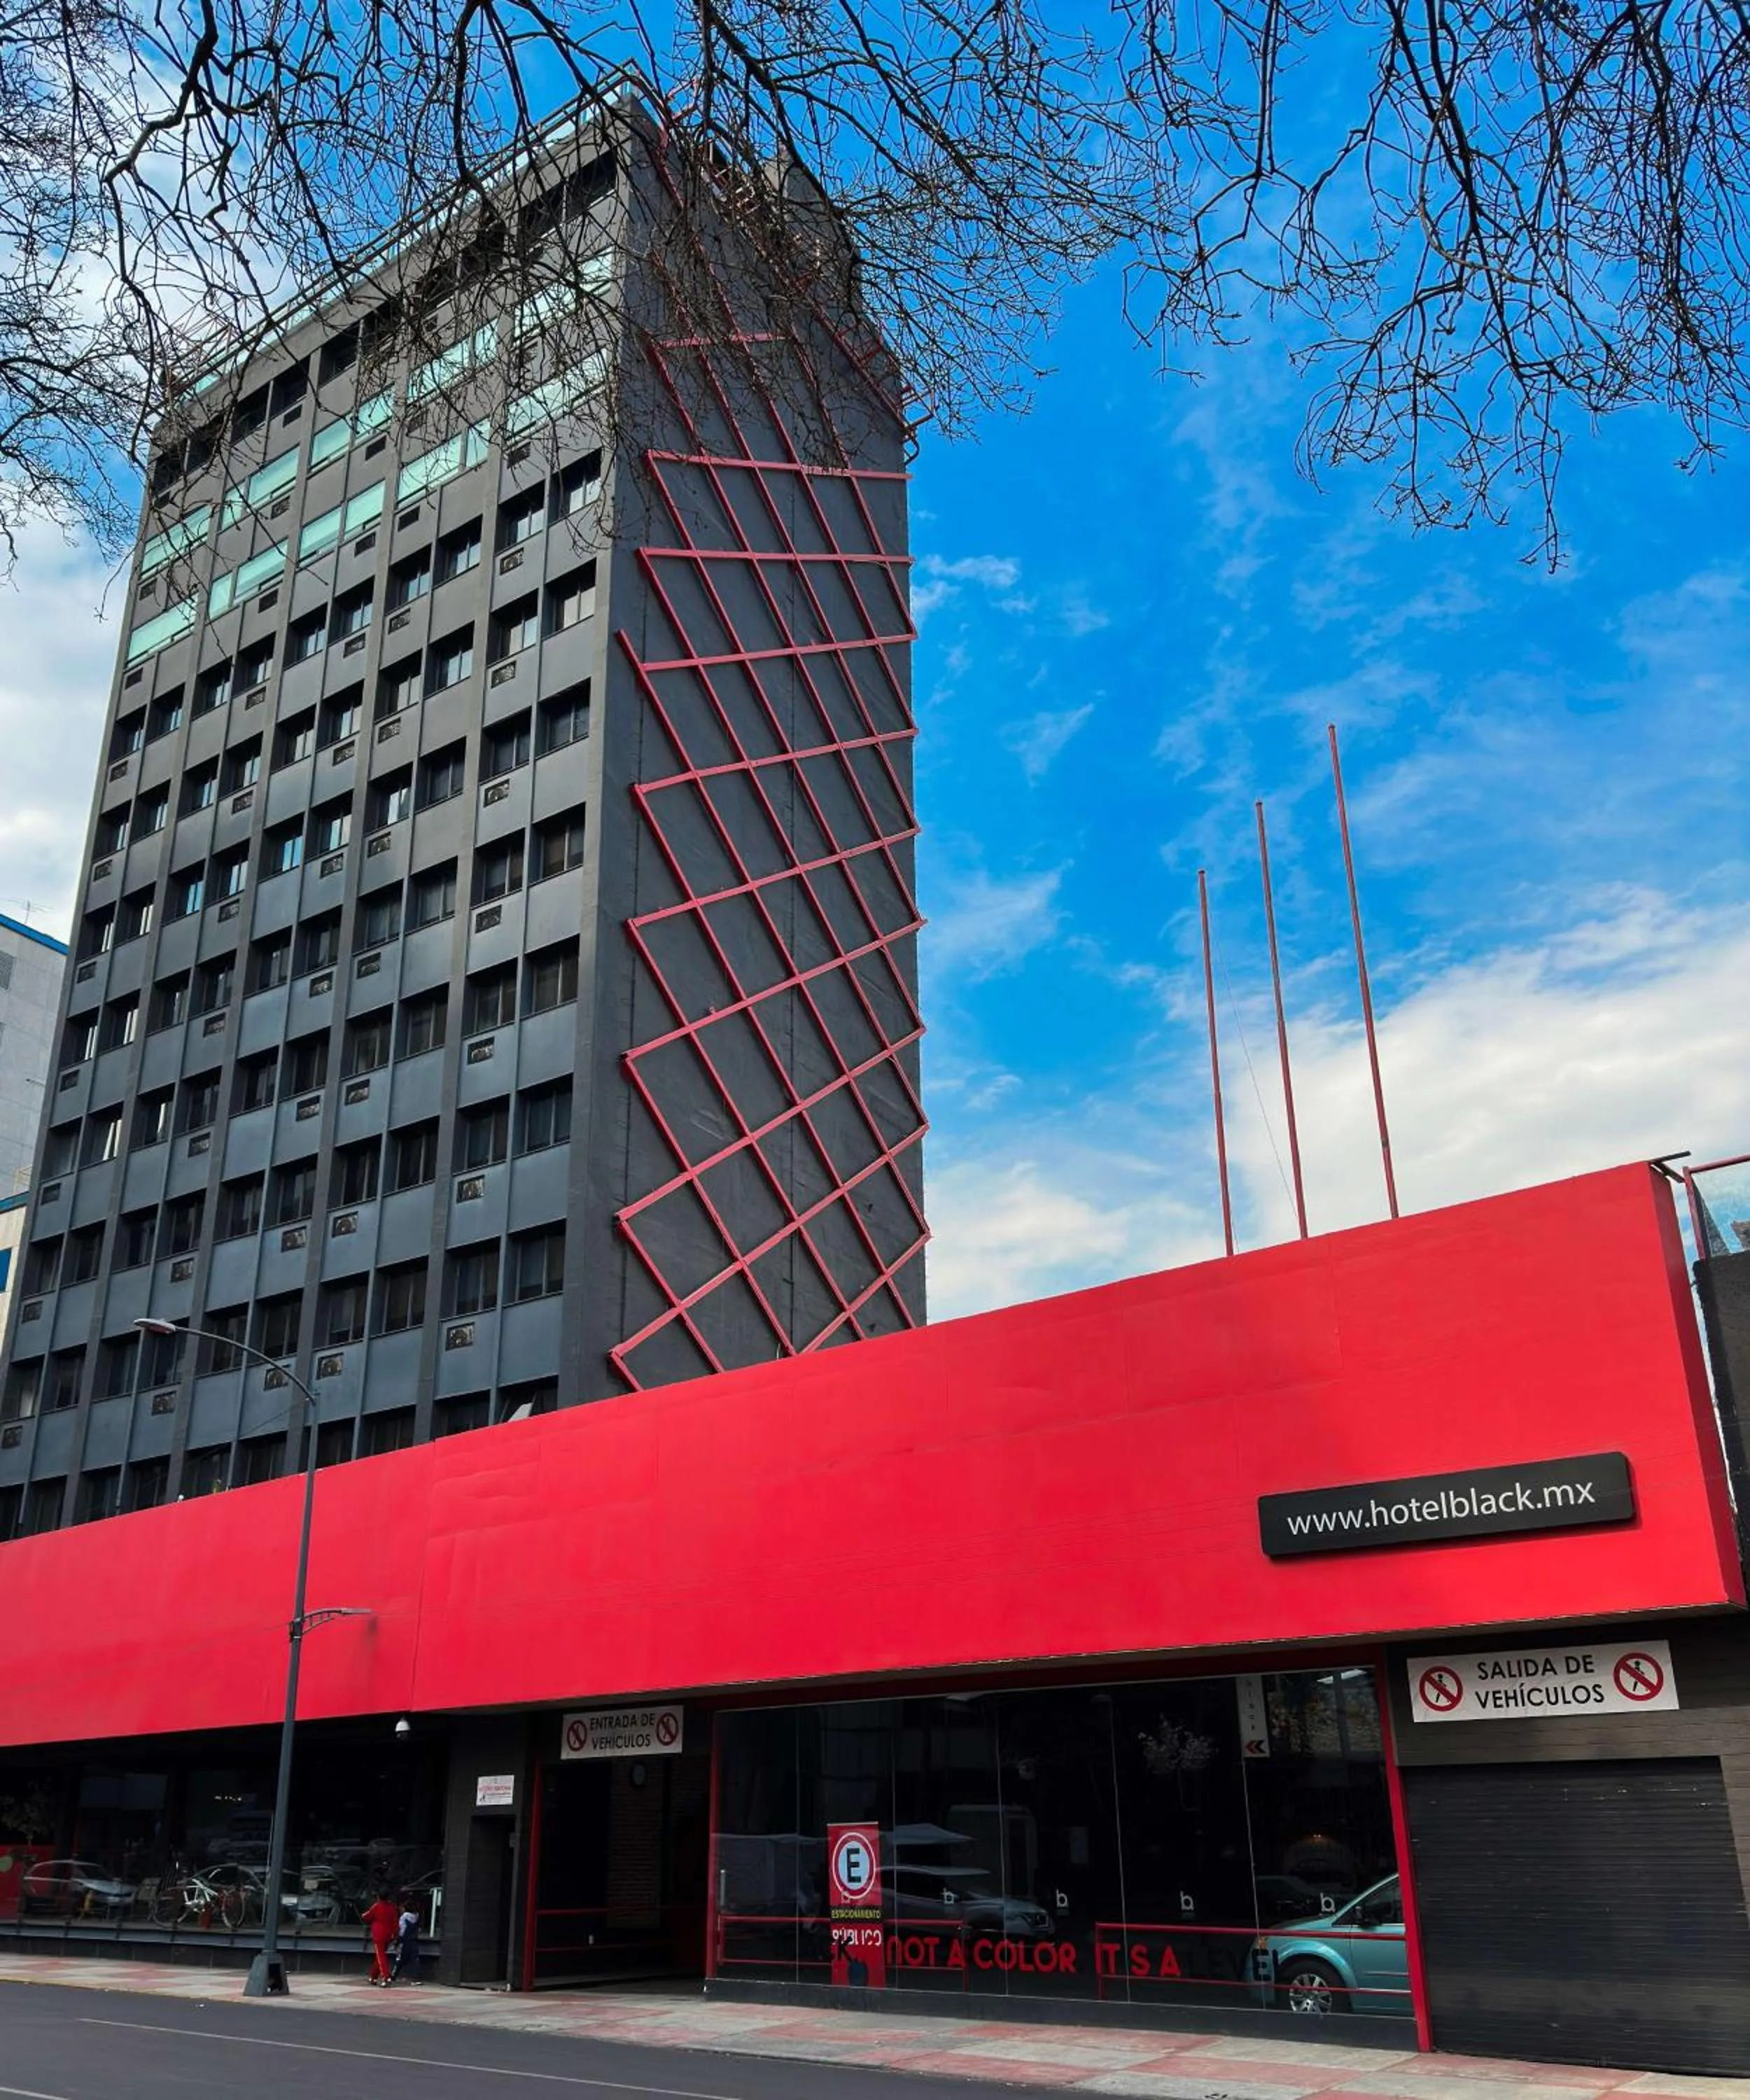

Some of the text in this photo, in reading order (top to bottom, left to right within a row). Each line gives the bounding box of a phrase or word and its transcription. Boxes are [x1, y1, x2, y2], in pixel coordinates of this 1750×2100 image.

[1287, 1482, 1596, 1535] www.hotelblack.mx
[1478, 1654, 1595, 1680] SALIDA DE
[1475, 1683, 1605, 1709] VEHÍCULOS
[590, 1713, 655, 1731] ENTRADA DE
[846, 1847, 862, 1884] E
[1056, 1888, 1070, 1908] b
[1179, 1890, 1194, 1911] b
[1320, 1892, 1336, 1912] b
[831, 1909, 881, 1919] ESTACIONAMIENTO
[886, 1935, 940, 1968] NOT
[947, 1937, 966, 1968] A
[974, 1938, 1077, 1973] COLOR
[1159, 1943, 1181, 1977] A
